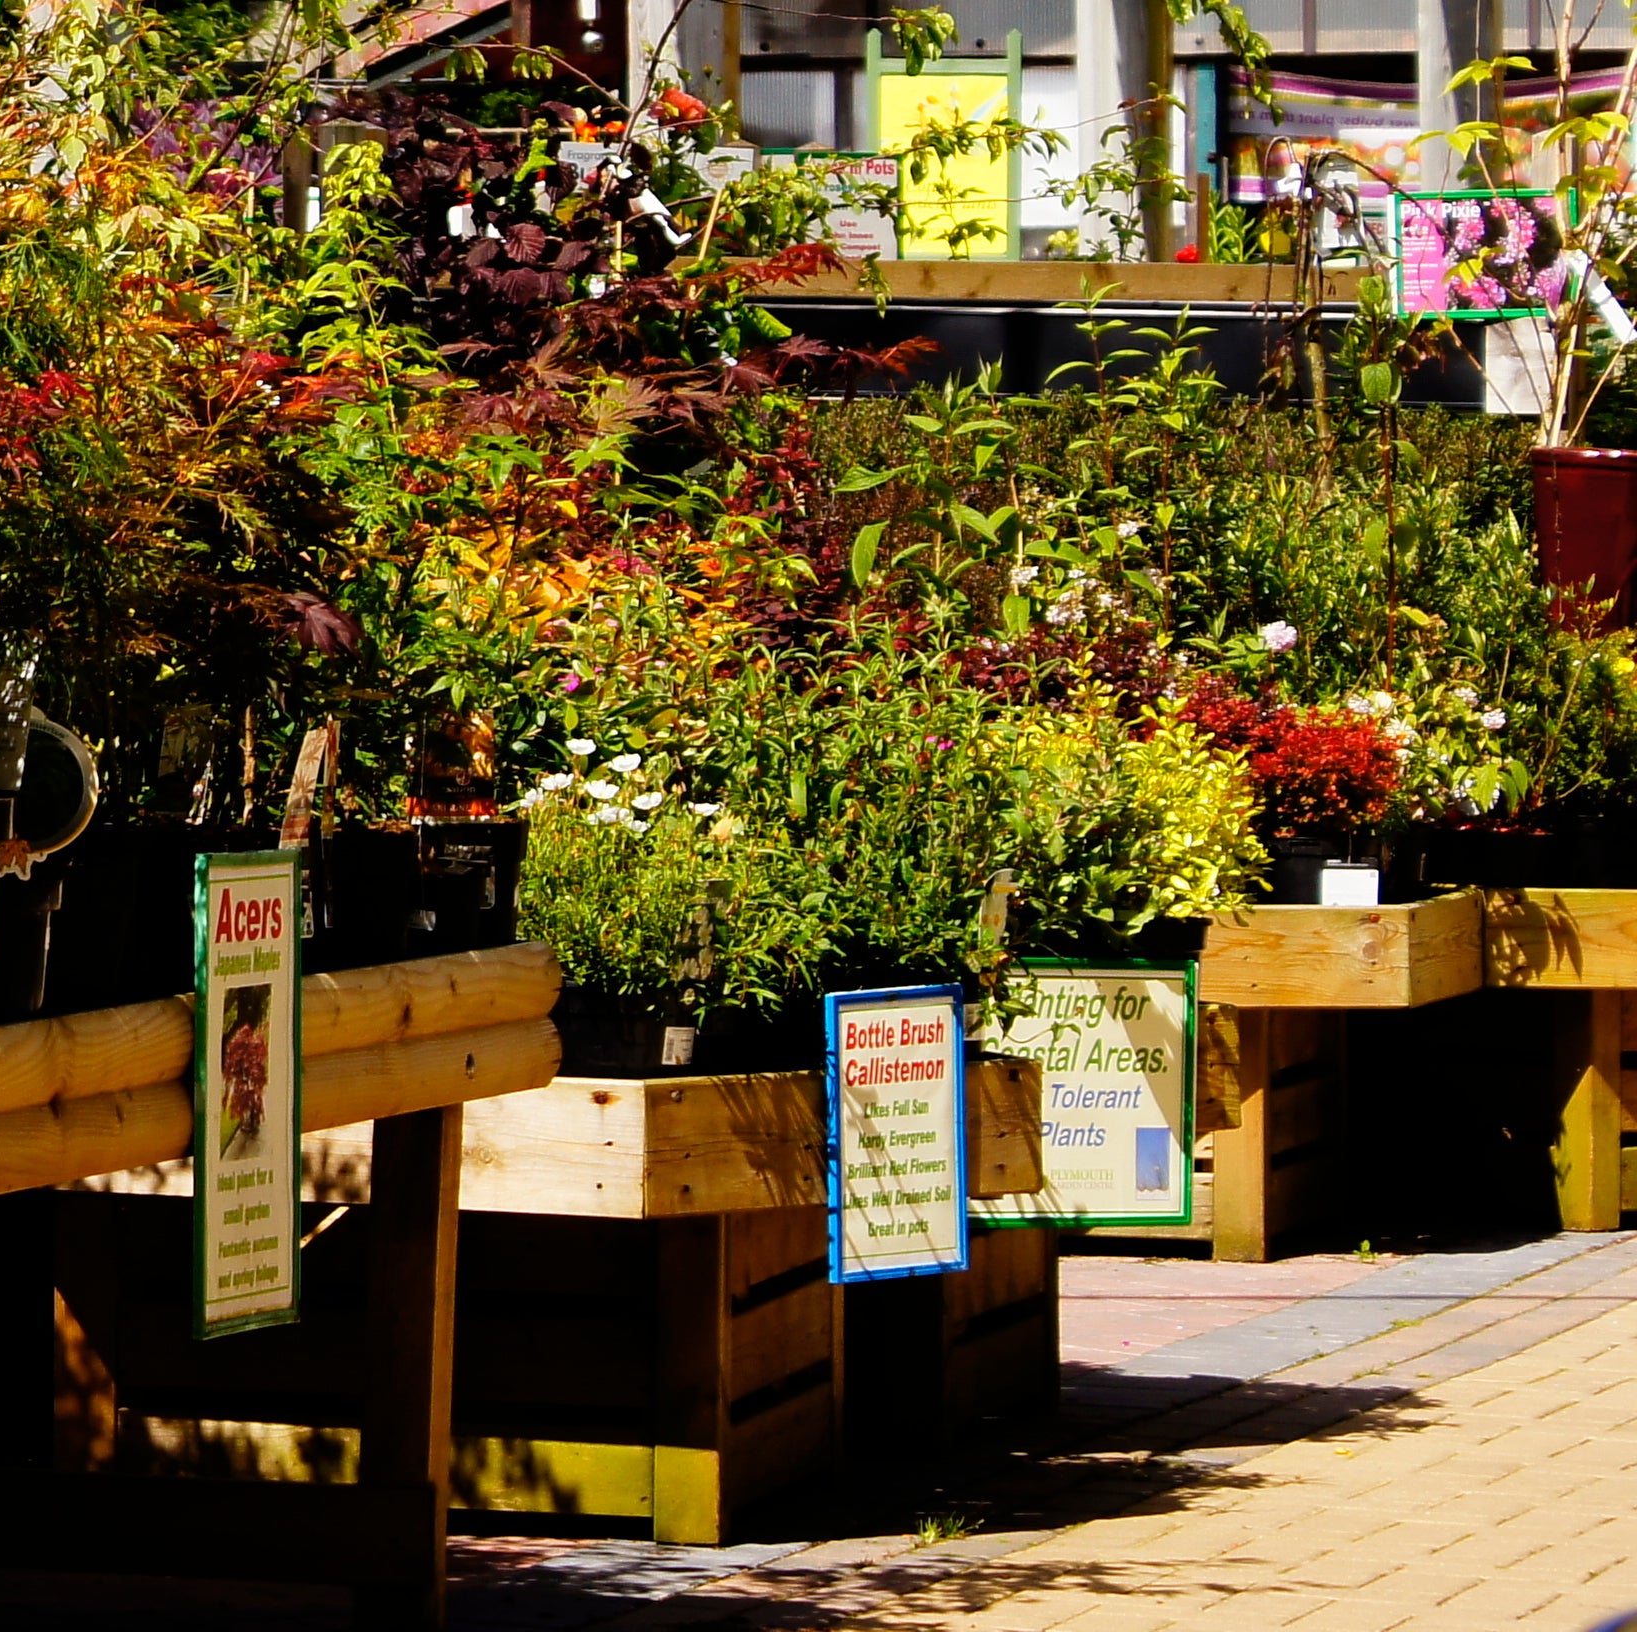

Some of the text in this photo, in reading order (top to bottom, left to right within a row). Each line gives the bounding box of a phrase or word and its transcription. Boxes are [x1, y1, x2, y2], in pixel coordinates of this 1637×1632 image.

[866, 159, 894, 175] Pots
[1442, 202, 1481, 218] Pixie
[215, 888, 282, 944] Acers
[1023, 986, 1151, 1028] anting for
[845, 1015, 944, 1050] Bottle Brush
[1084, 1038, 1169, 1073] Areas.
[845, 1057, 945, 1087] Callistemon
[892, 1099, 910, 1116] Full
[912, 1099, 929, 1115] Sun
[1051, 1083, 1142, 1109] Tolerant
[858, 1129, 936, 1151] Hardy Evergreen
[1042, 1122, 1106, 1147] Plants
[847, 1157, 947, 1180] Brilliant Red Flowers
[871, 1189, 893, 1208] Well
[895, 1186, 933, 1206] Drained
[934, 1184, 952, 1202] Soil
[867, 1219, 929, 1238] Great in pots
